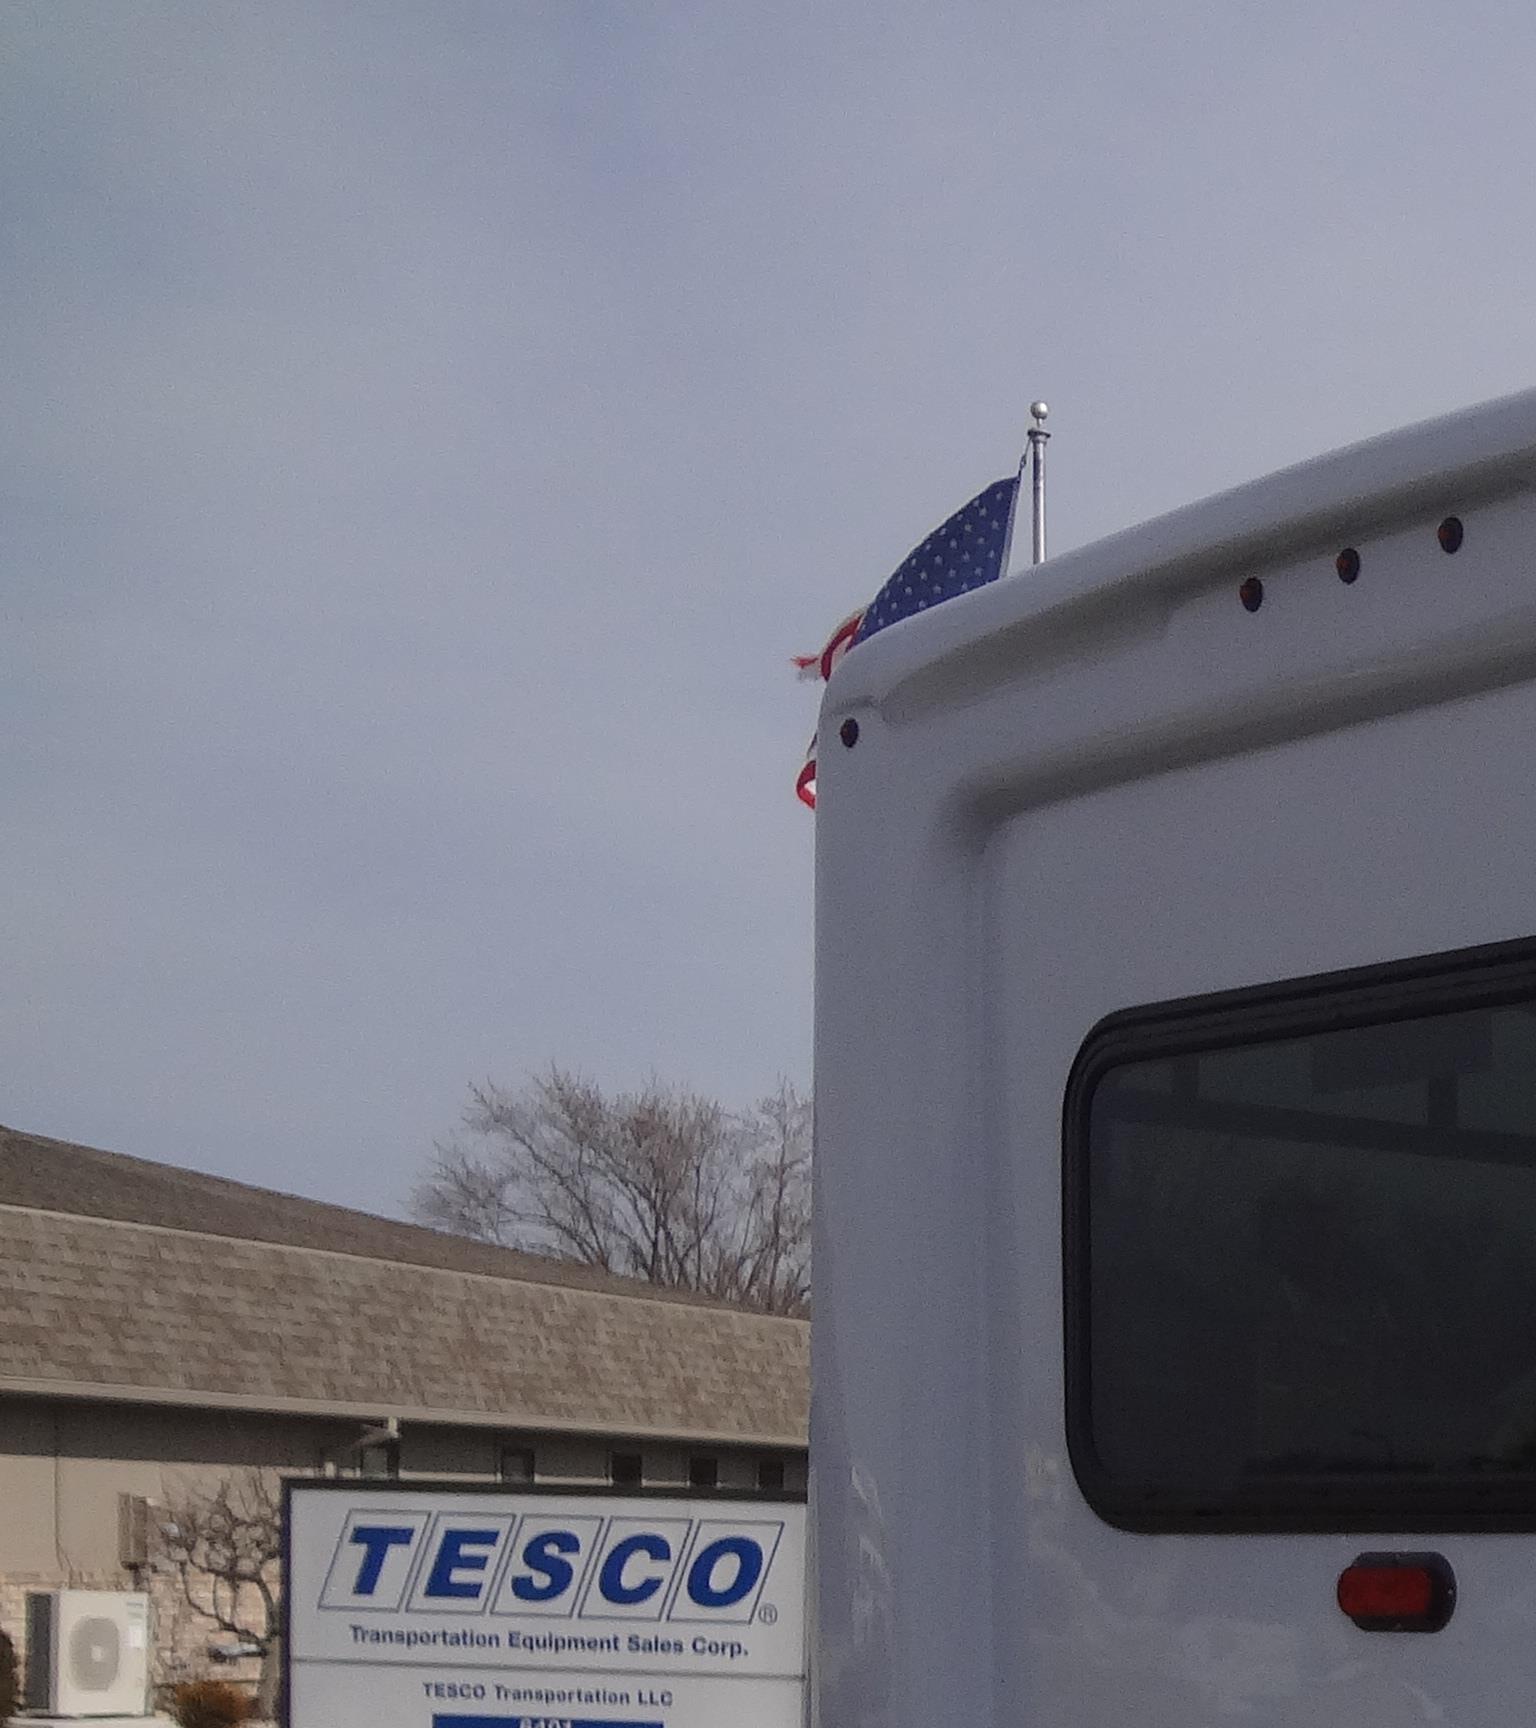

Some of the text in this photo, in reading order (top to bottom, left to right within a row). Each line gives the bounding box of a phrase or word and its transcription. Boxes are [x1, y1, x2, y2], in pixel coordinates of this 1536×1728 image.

[349, 1526, 763, 1608] TESCO
[350, 1624, 749, 1659] Transportation Equipment Sales Corp.
[423, 1682, 674, 1707] TESCO Transportation LLC
